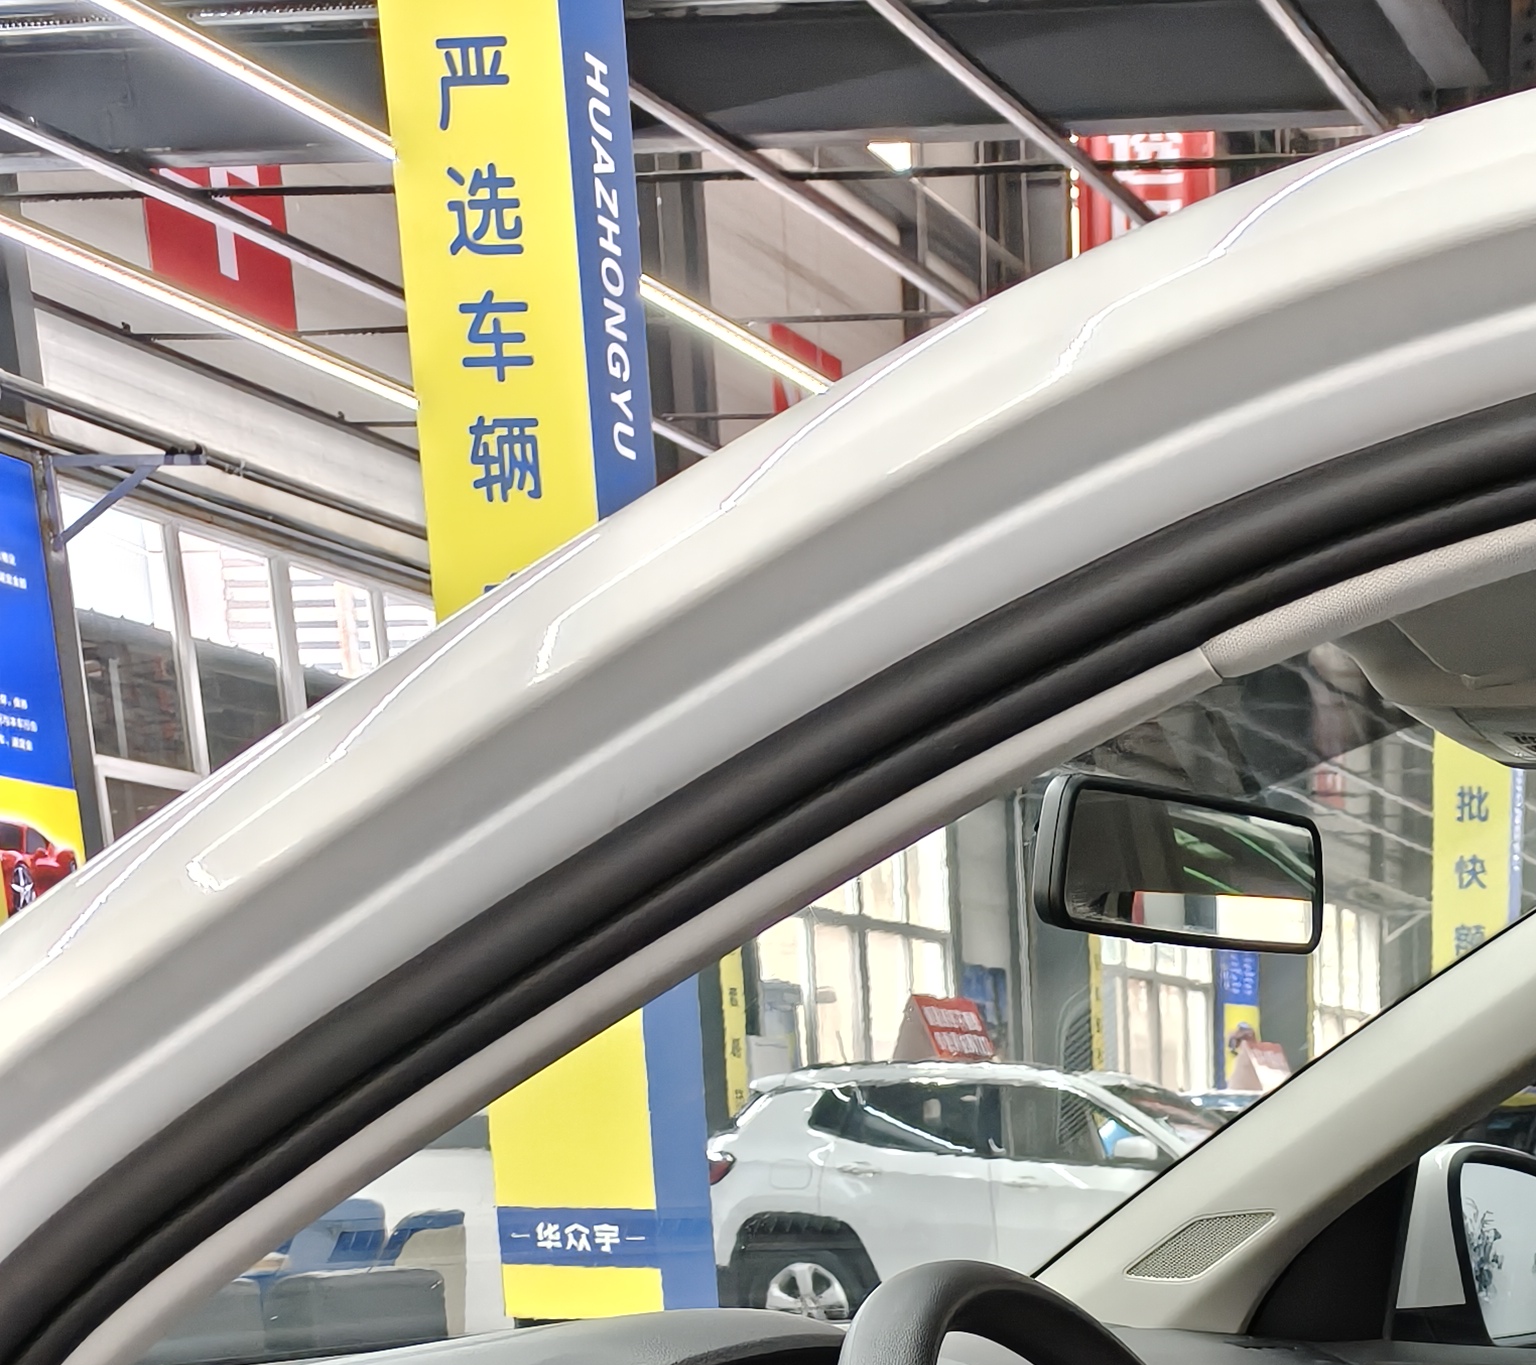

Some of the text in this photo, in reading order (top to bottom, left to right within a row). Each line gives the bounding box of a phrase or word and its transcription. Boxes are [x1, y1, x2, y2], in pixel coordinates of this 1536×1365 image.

[435, 36, 541, 502] 严选车辆
[585, 52, 637, 461] HUAZHONGYU
[535, 1221, 621, 1254] 华众宇
